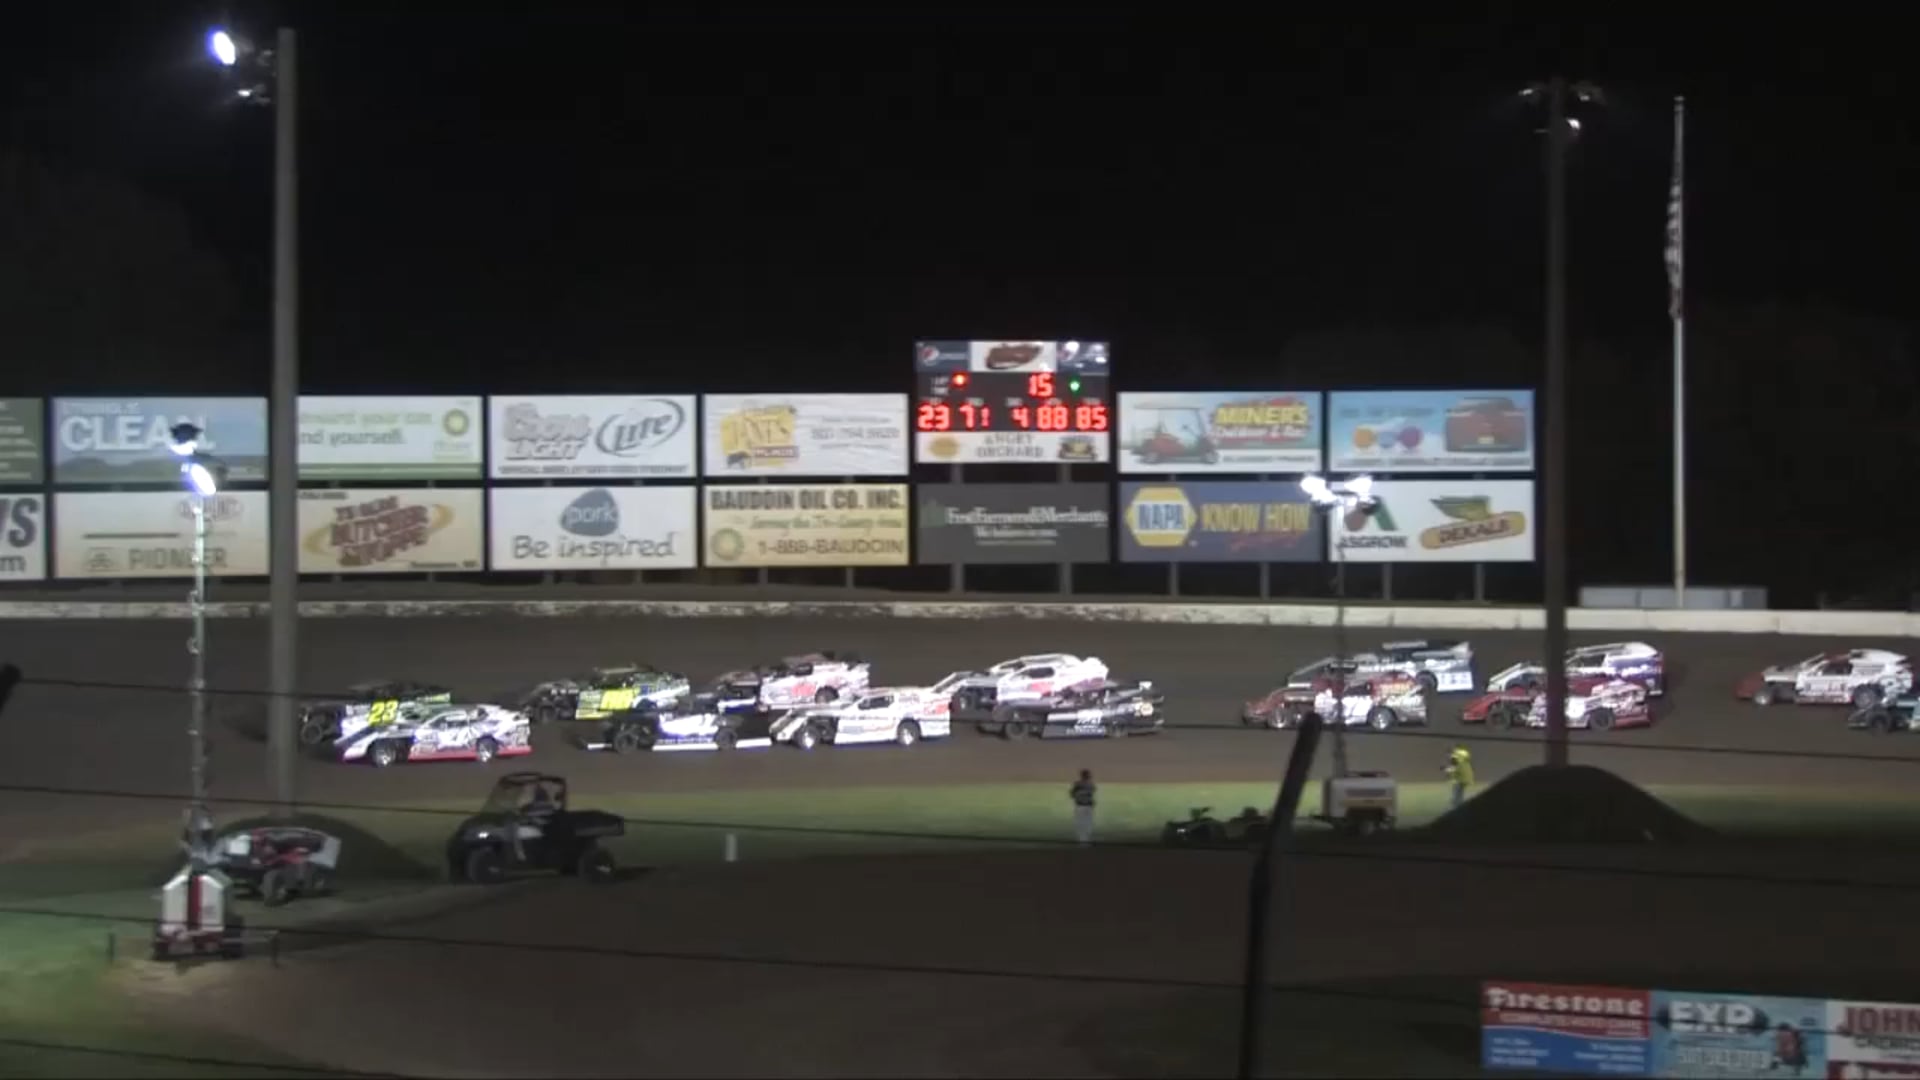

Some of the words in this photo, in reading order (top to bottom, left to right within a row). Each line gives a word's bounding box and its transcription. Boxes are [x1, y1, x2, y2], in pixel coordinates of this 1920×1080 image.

[1028, 374, 1053, 397] 15
[918, 405, 950, 430] 23
[1012, 407, 1029, 429] 4
[1036, 405, 1068, 430] 88
[1075, 405, 1108, 430] 85
[976, 446, 1044, 457] ORCHARD
[711, 488, 795, 510] BAUDOIN
[800, 488, 828, 510] OIL
[832, 488, 864, 510] CO.
[866, 488, 906, 510] INC.
[567, 502, 618, 525] pork
[1137, 503, 1185, 530] NAPA
[1202, 503, 1260, 532] KNOW
[1265, 503, 1312, 531] HOW
[129, 548, 228, 568] PIONER
[512, 535, 551, 559] Be
[558, 531, 677, 566] inspired
[368, 699, 398, 726] 23
[1486, 987, 1644, 1015] Firestone
